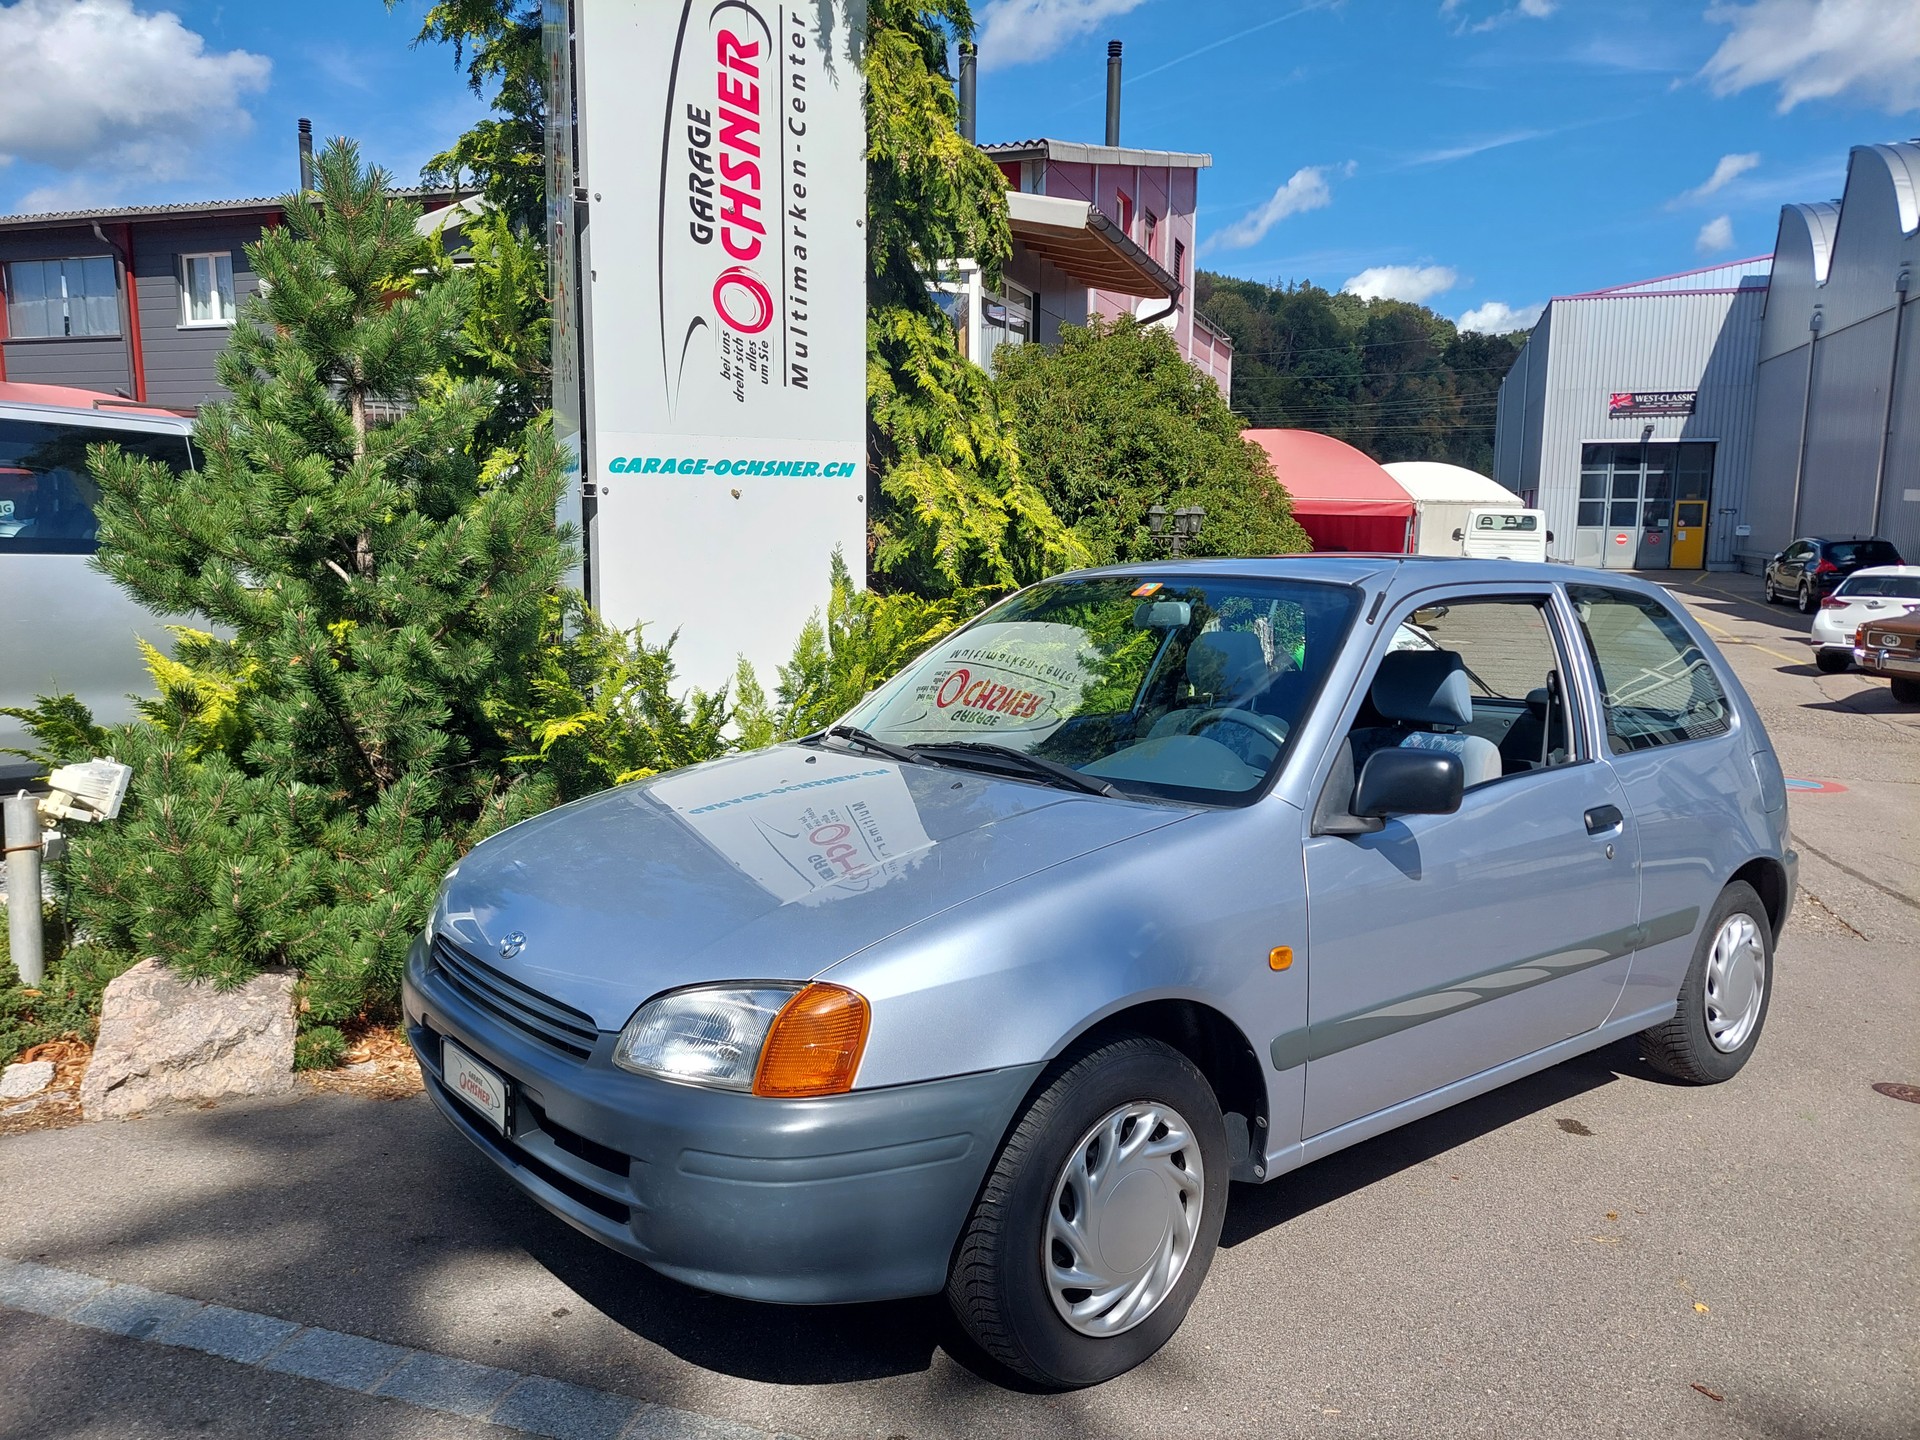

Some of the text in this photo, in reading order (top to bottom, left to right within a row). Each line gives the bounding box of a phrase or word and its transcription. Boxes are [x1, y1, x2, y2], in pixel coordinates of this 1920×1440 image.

[687, 104, 714, 245] GARAGE
[712, 29, 774, 335] OCHSNER
[788, 12, 810, 390] Multimarken-Center
[720, 330, 731, 381] bei uns
[732, 337, 745, 403] dreht sich
[746, 339, 757, 372] alles
[758, 340, 769, 385] um Sie
[1635, 393, 1696, 402] WEST-CLASSIC
[608, 456, 857, 478] GARAGE-OCHSNER.CH
[1884, 635, 1897, 645] CH
[460, 1072, 491, 1106] OCHSNER
